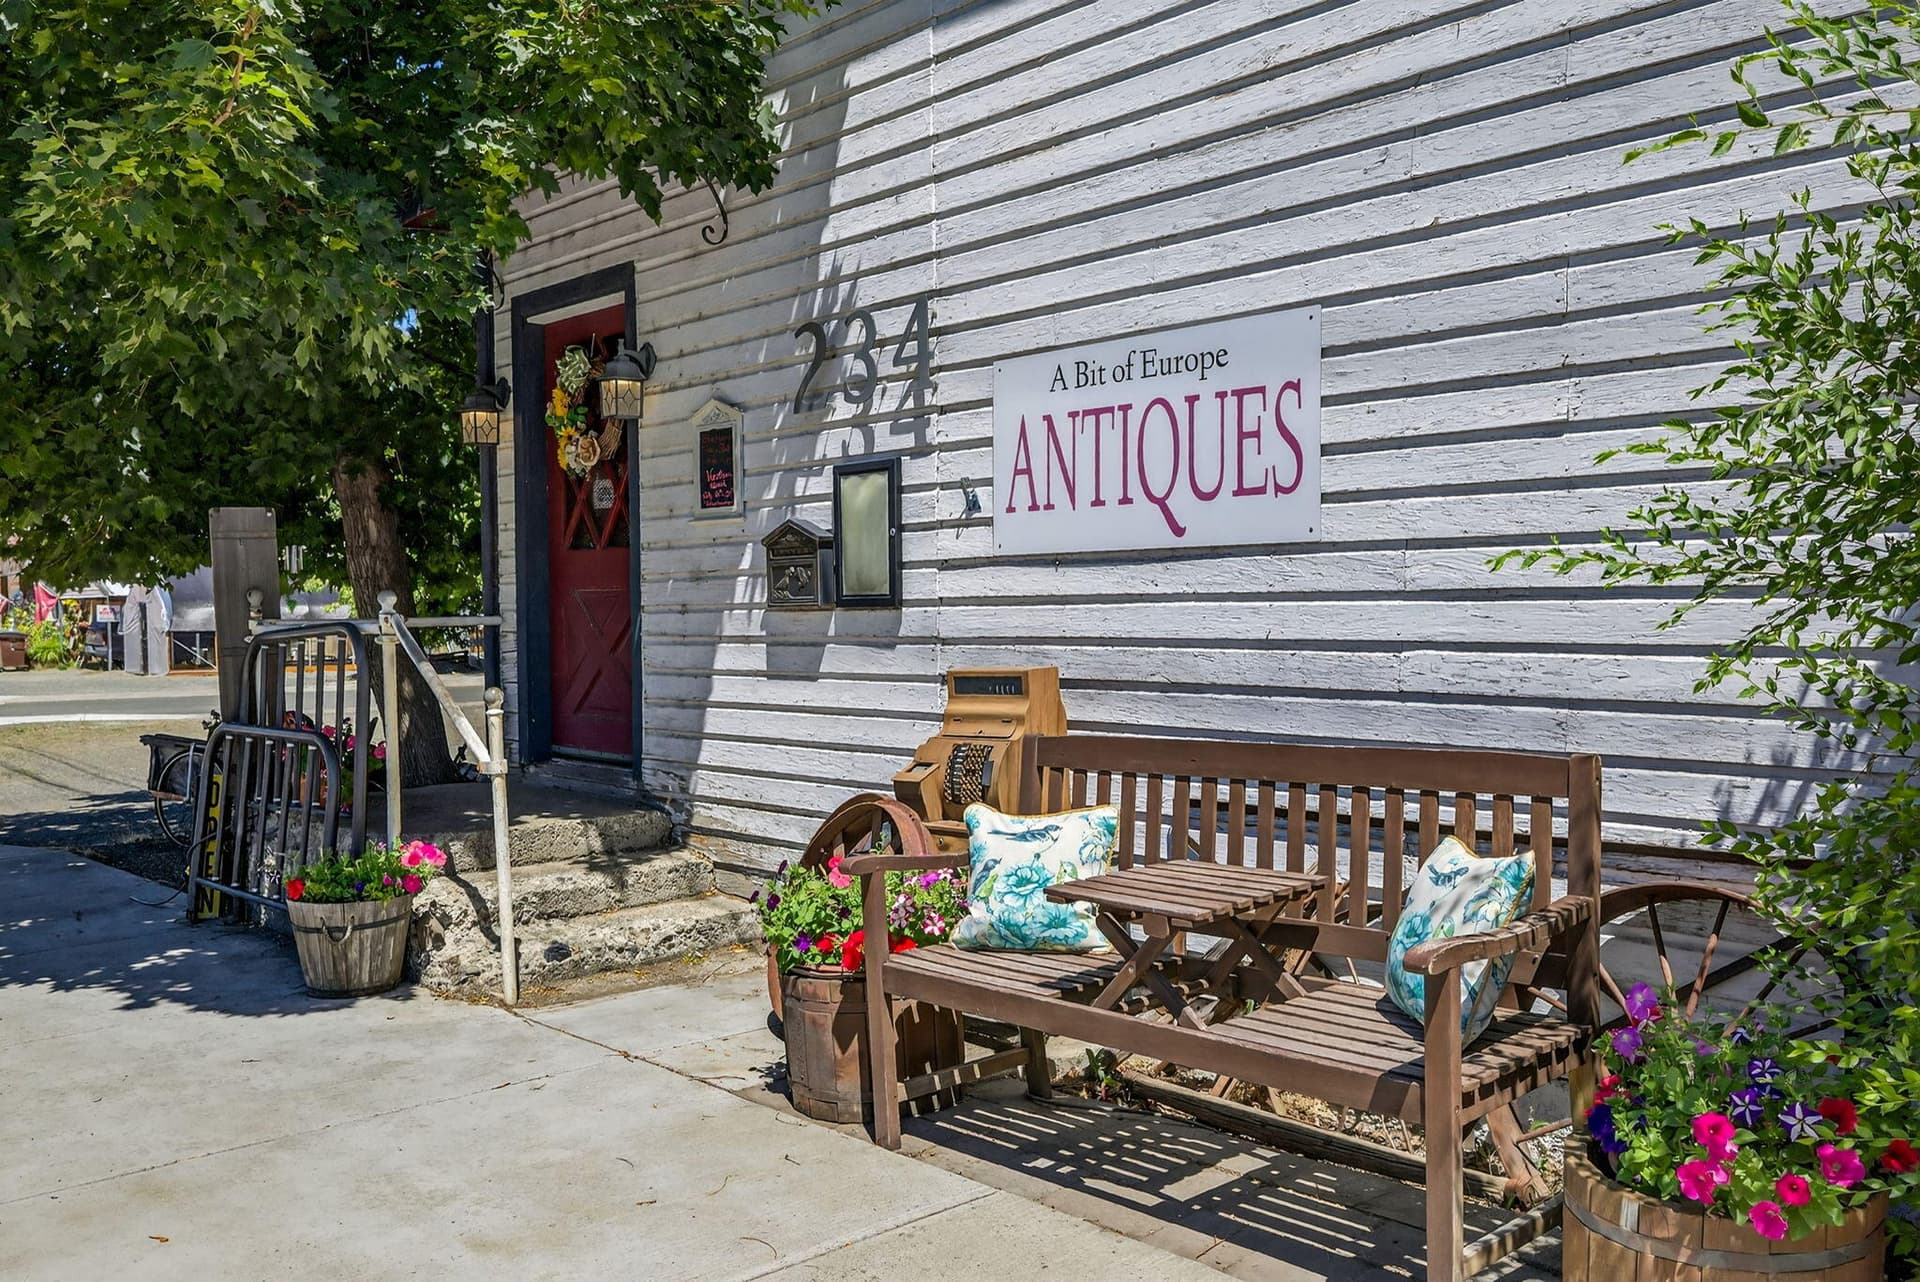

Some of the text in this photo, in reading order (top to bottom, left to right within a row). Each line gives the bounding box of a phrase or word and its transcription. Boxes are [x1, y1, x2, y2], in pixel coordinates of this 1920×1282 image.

[793, 293, 935, 414] 234
[1049, 348, 1229, 393] A Bit of Europe
[1005, 378, 1305, 539] ANTIQUES
